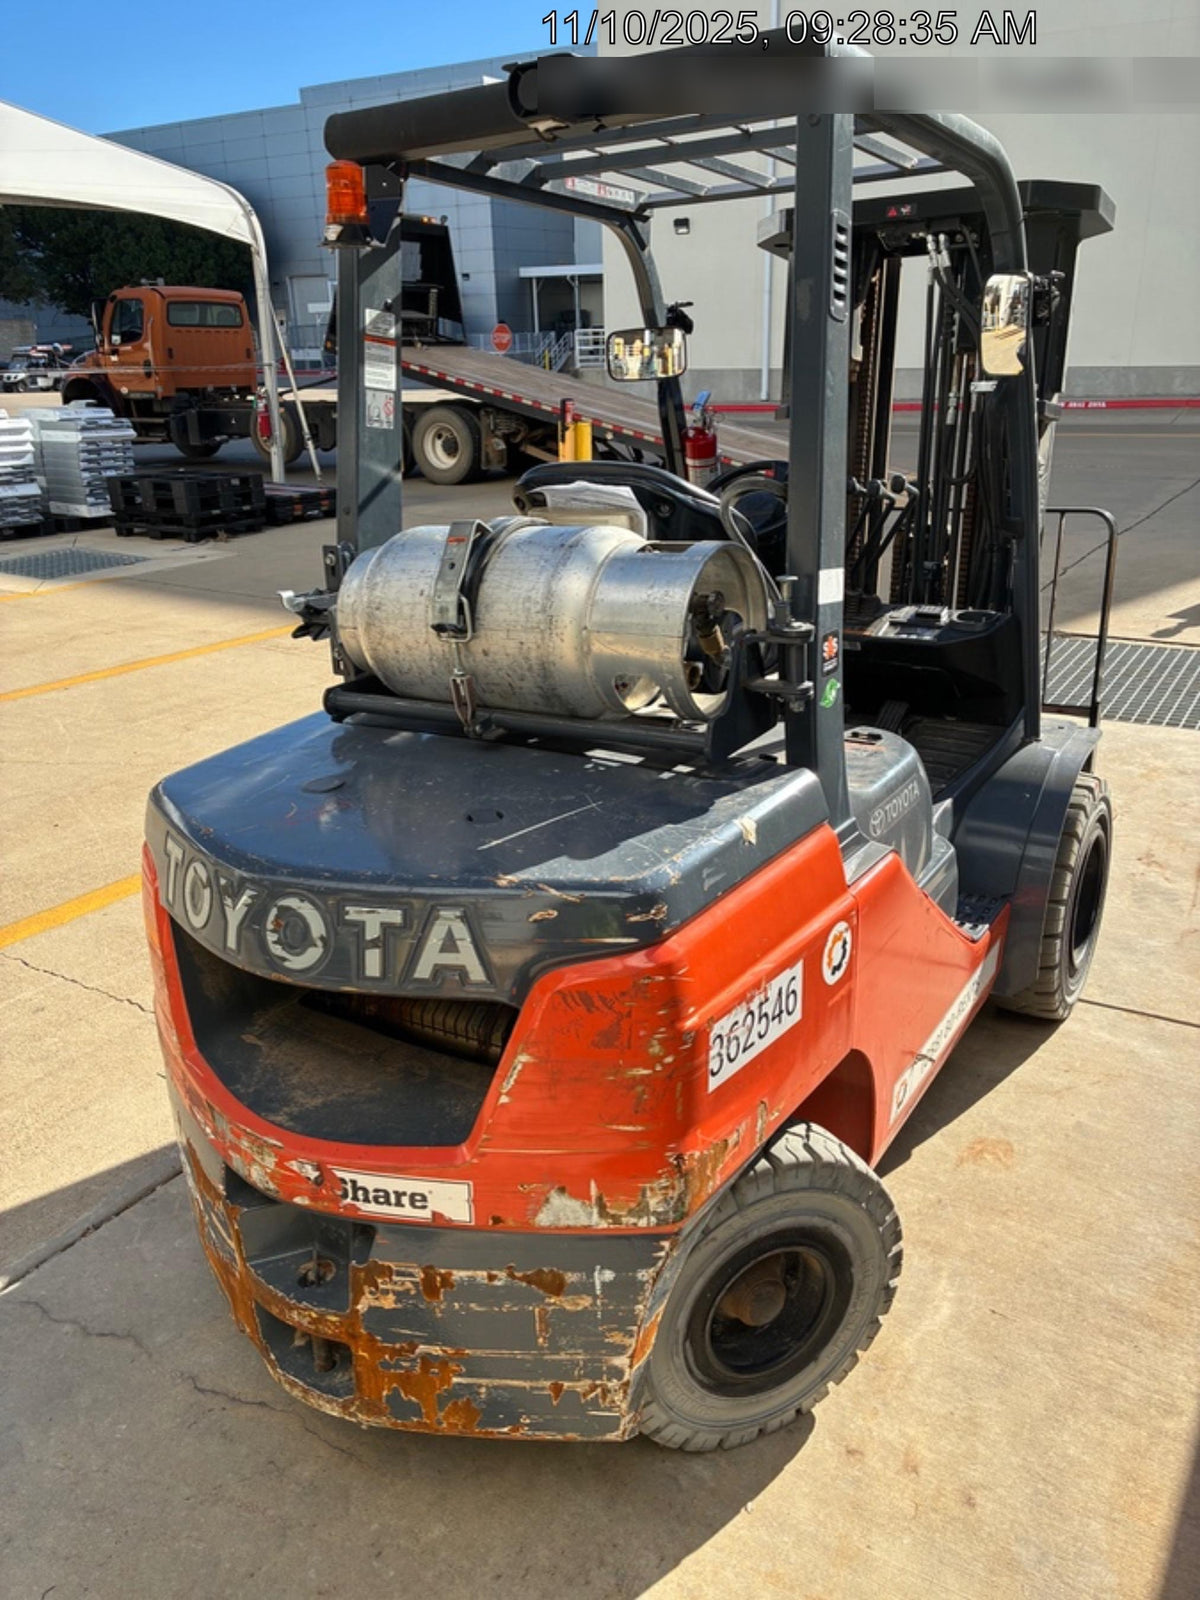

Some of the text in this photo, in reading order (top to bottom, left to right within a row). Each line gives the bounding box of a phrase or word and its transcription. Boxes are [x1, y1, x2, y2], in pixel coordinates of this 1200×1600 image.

[885, 780, 919, 822] TOYOTA
[164, 830, 489, 983] TOYOTA
[709, 975, 798, 1078] 362546
